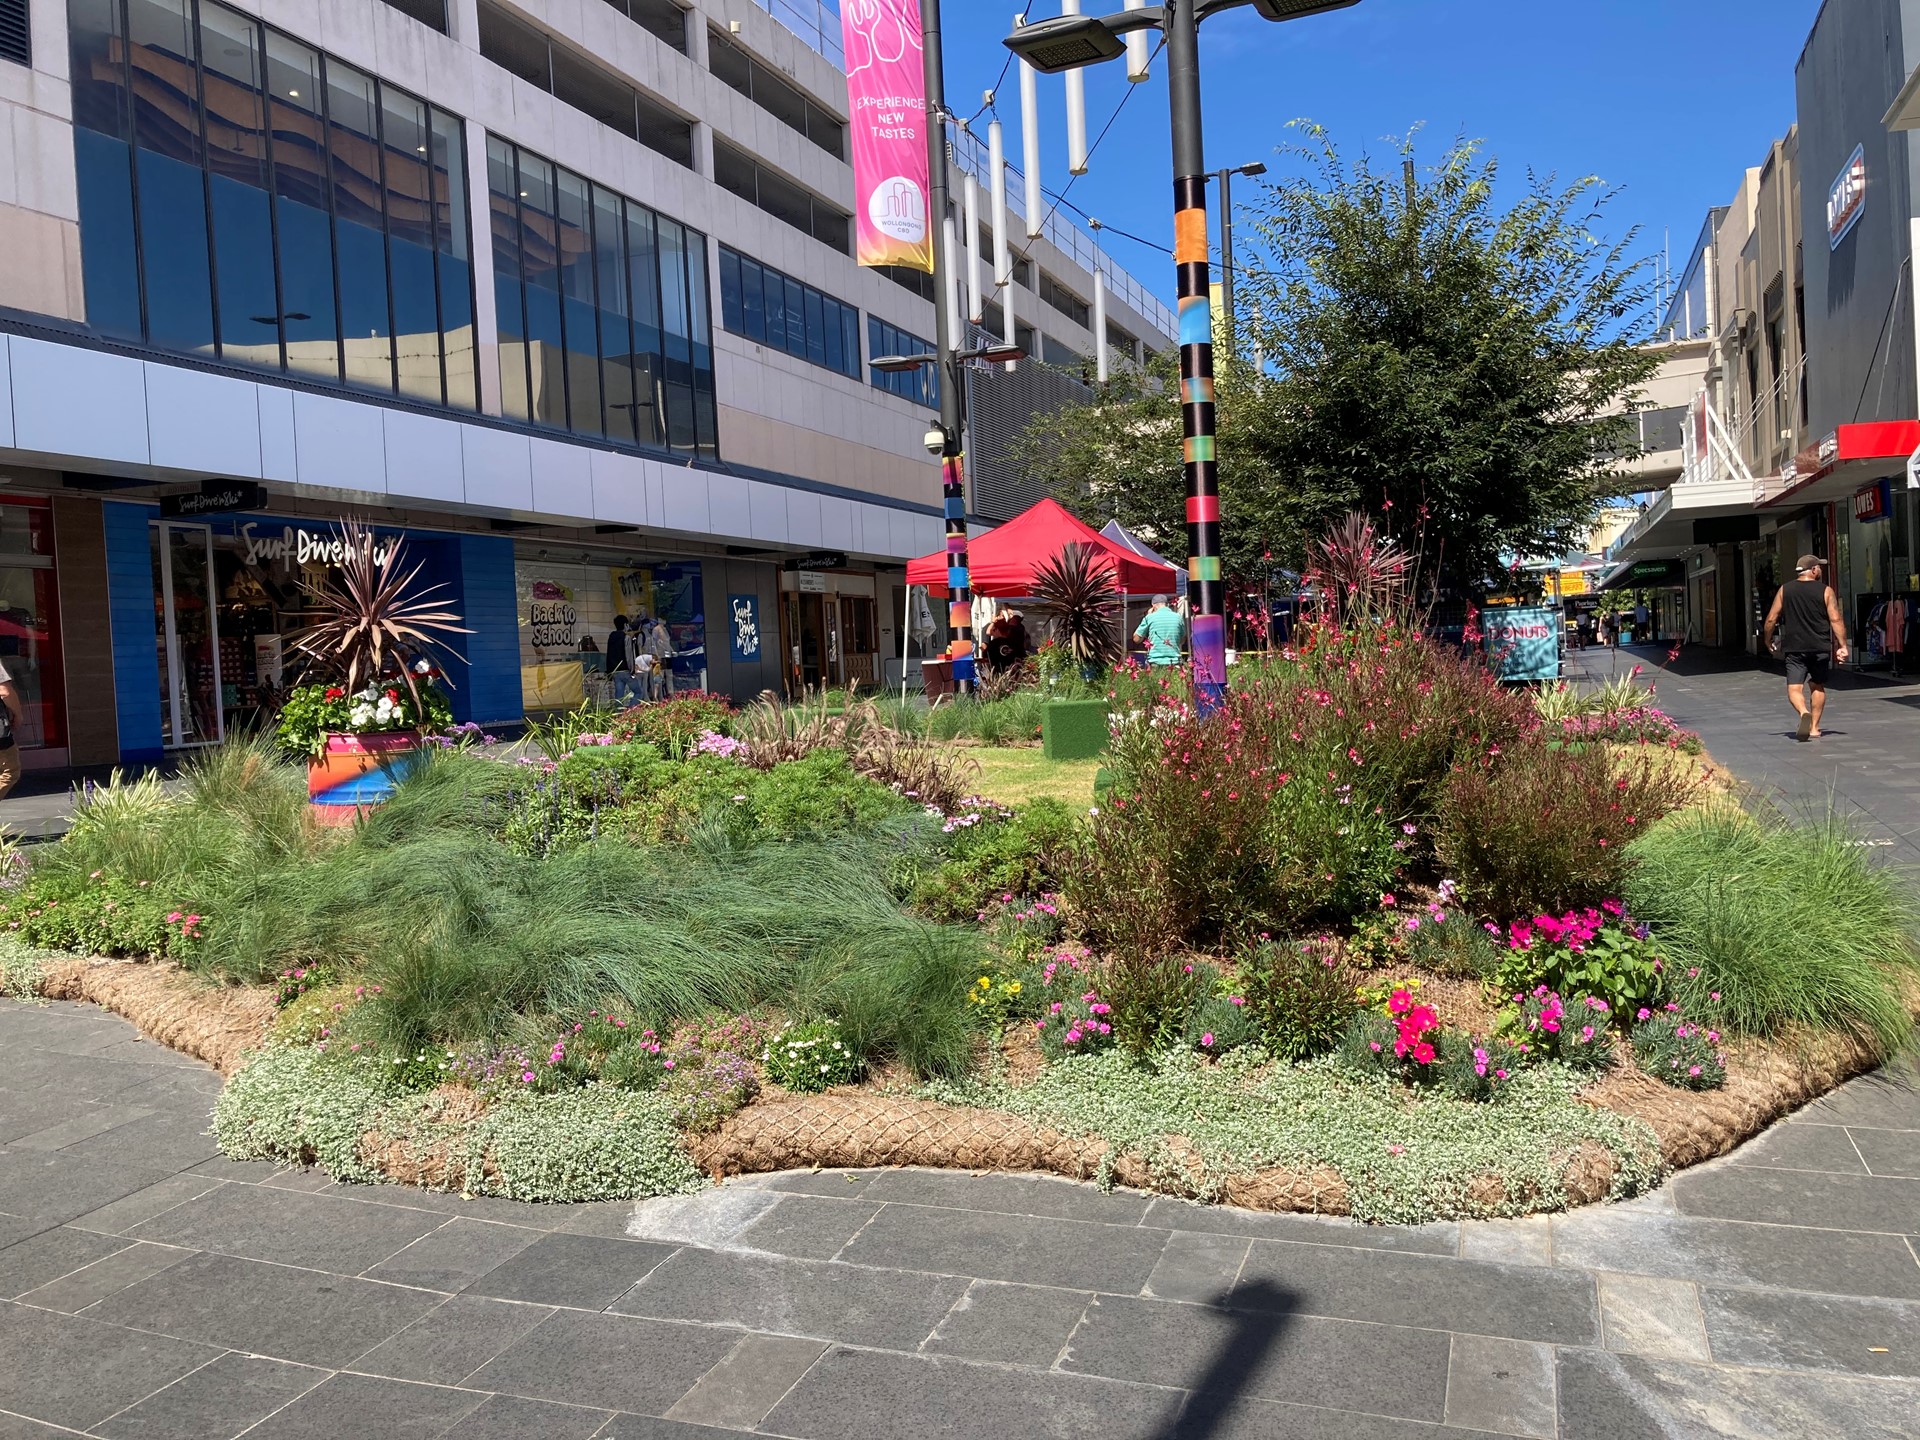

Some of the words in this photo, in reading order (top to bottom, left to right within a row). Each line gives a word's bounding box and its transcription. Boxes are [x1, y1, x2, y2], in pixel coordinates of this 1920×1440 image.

[857, 96, 926, 110] EXPERIENCE
[877, 112, 905, 124] NEW
[871, 126, 915, 139] TASTES
[881, 220, 922, 230] WOLLONGONG
[178, 494, 199, 513] Surf
[1853, 490, 1874, 516] LOWES
[241, 522, 297, 573] Surf
[1633, 566, 1666, 575] Specsavers
[530, 602, 562, 626] Back
[562, 604, 577, 625] to
[732, 599, 752, 626] Surf
[531, 624, 575, 648] School
[738, 618, 756, 637] Dive
[1488, 625, 1549, 641] DONUTS
